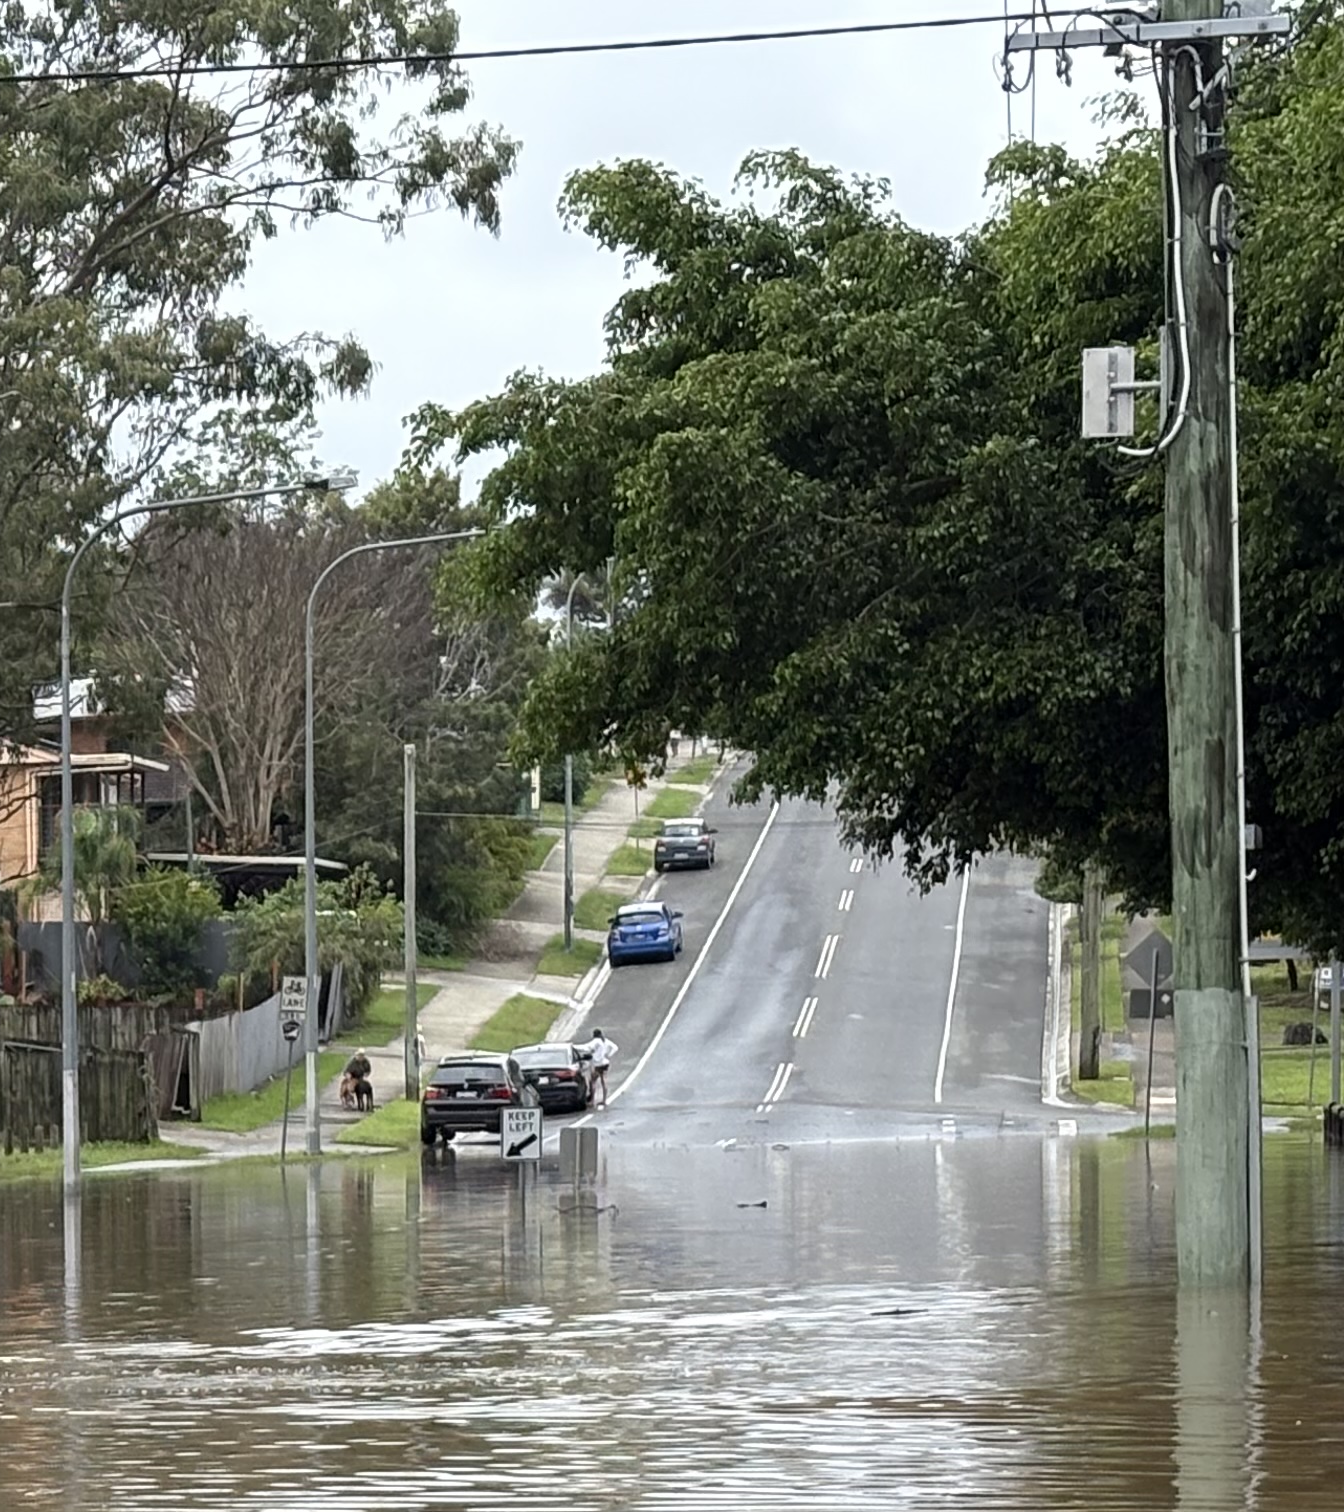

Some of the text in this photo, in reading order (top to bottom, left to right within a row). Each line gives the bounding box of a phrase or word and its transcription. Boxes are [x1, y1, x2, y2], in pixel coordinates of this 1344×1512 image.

[282, 998, 305, 1008] LANE
[507, 1111, 536, 1121] KEEP
[508, 1121, 534, 1132] LEFT
